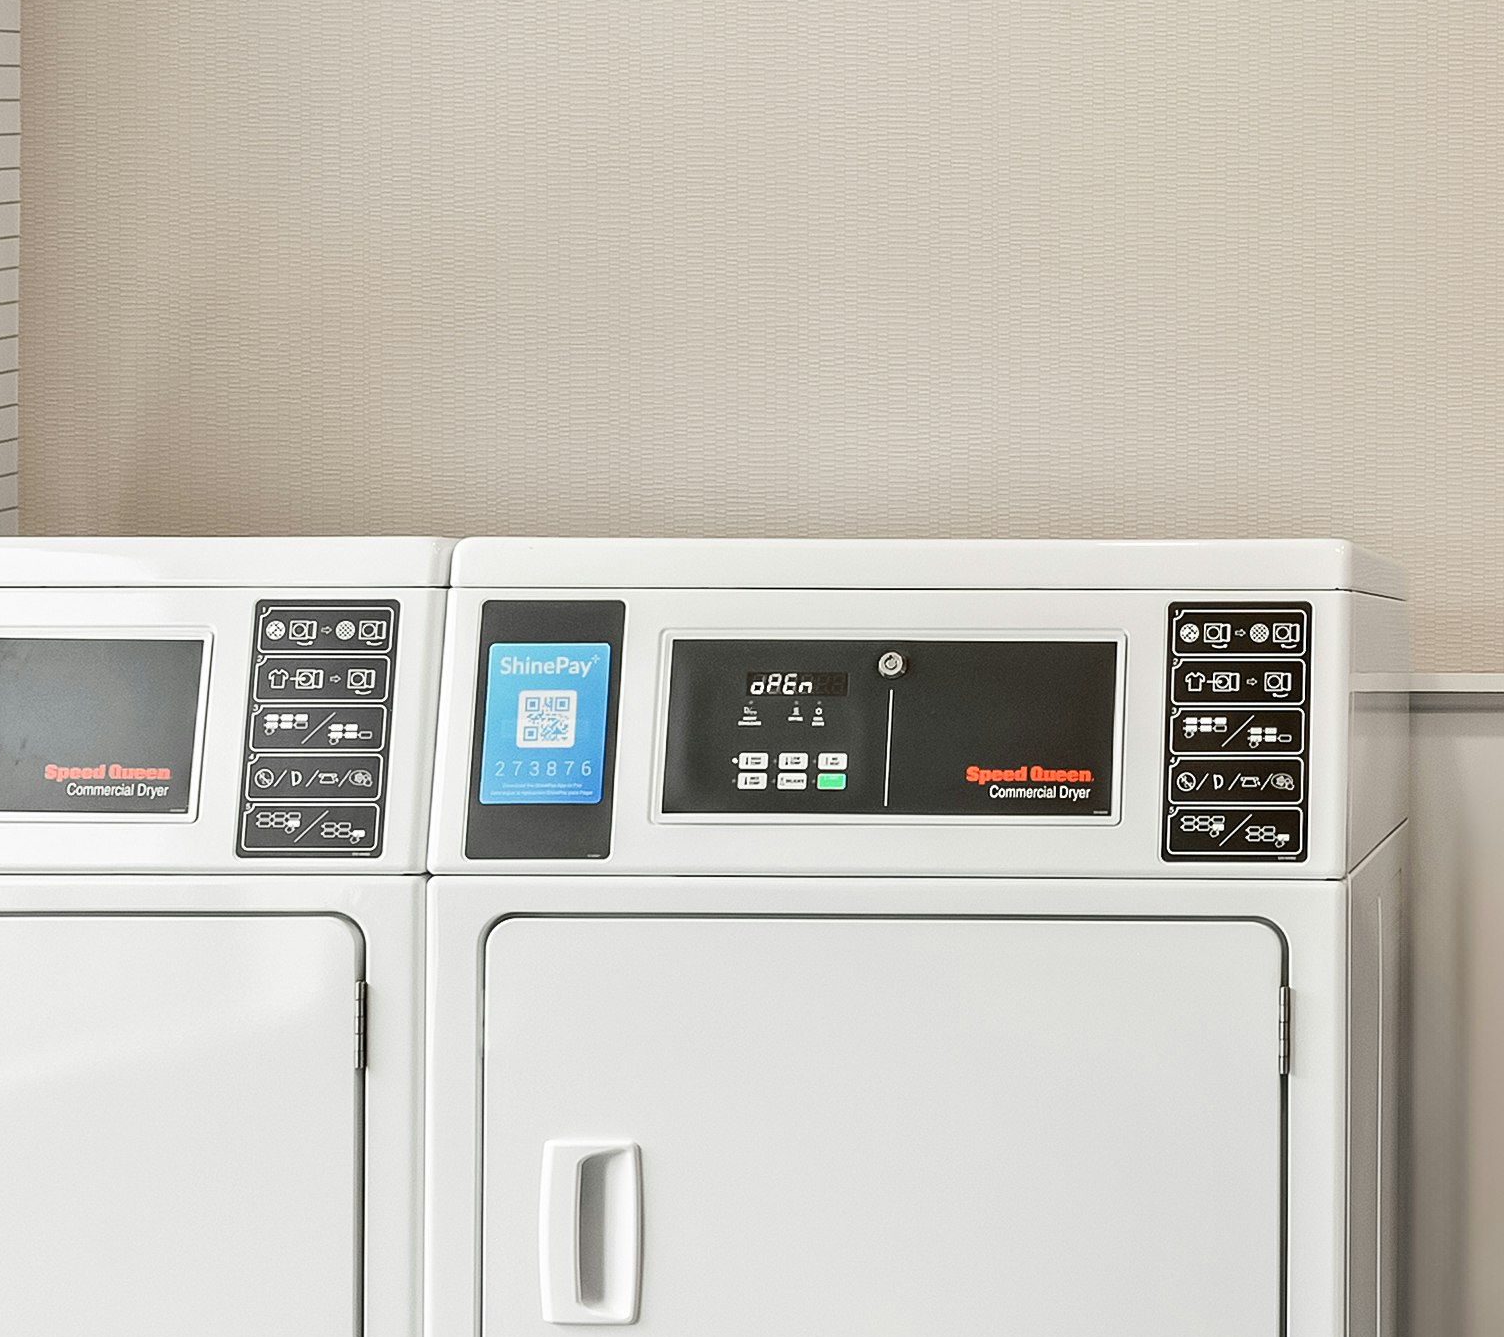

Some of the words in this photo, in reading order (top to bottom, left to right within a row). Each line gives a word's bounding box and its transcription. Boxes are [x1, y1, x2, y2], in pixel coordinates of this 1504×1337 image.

[500, 656, 592, 678] ShinePay
[44, 763, 106, 782] Speed
[108, 763, 171, 780] Queen
[495, 760, 592, 777] 273876
[965, 765, 1028, 785] Speed
[1030, 765, 1093, 782] Queen
[66, 782, 135, 797] Commercial
[136, 783, 170, 800] Dryer
[989, 784, 1056, 799] Commercial
[1059, 785, 1091, 802] Dryer
